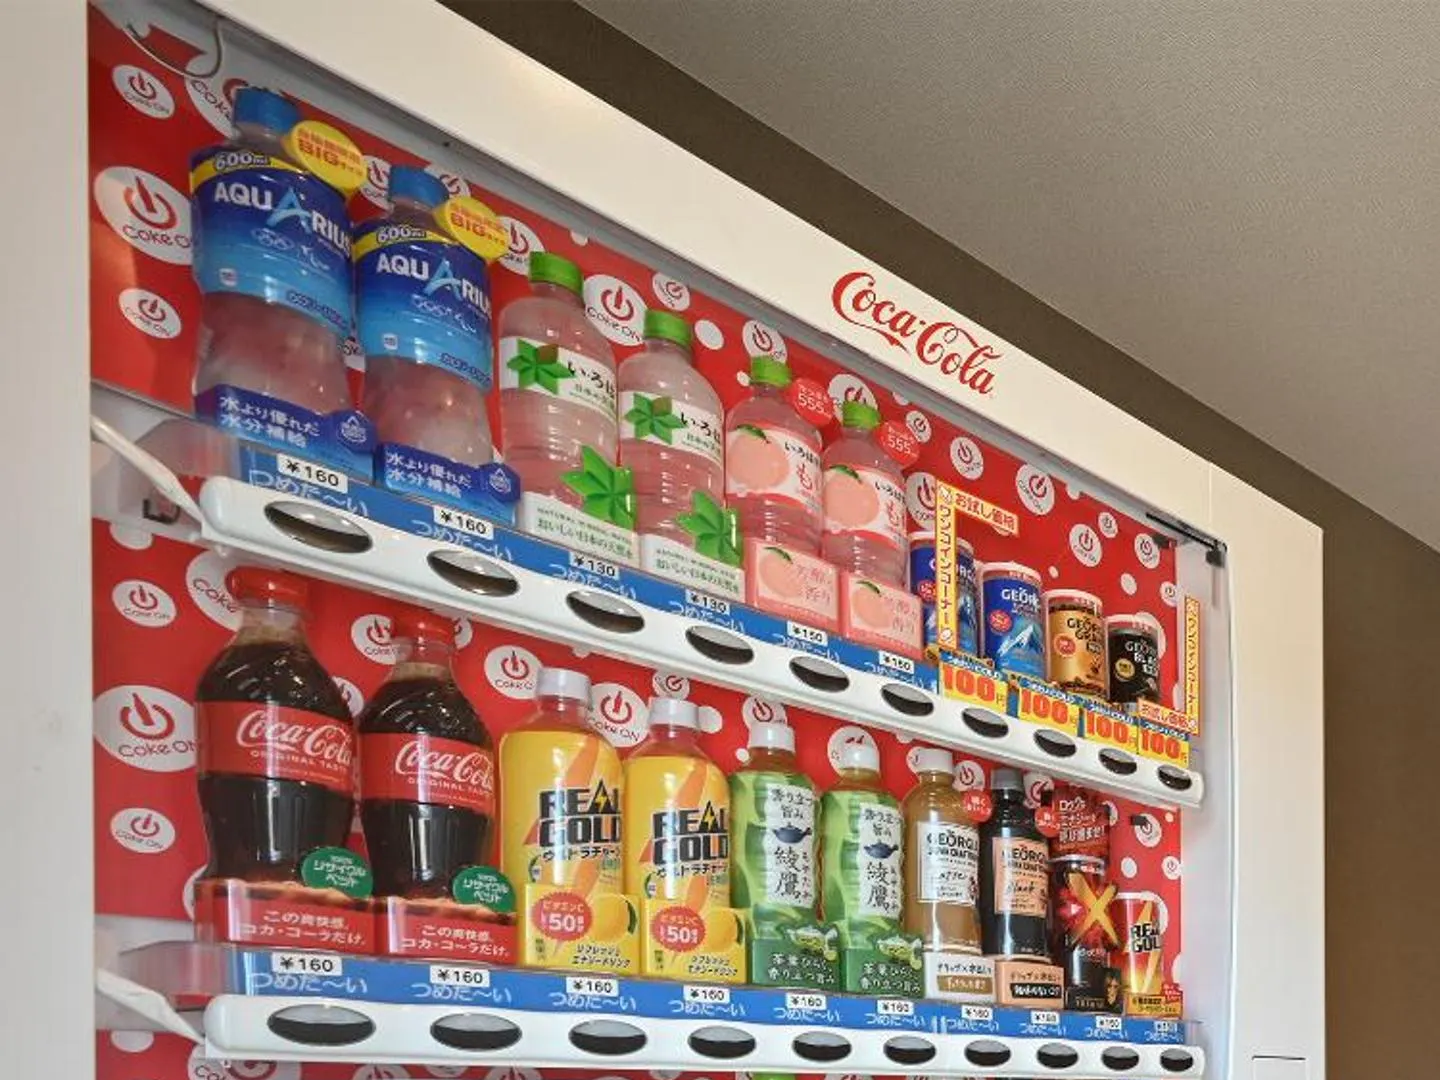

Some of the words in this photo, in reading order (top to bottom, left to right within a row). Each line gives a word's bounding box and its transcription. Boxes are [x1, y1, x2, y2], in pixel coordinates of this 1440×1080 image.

[214, 152, 270, 170] 600ml
[376, 226, 427, 243] 600ml
[375, 255, 492, 316] AQUARIU
[831, 271, 1003, 396] Coca-Cola
[220, 395, 320, 437] 水より優れた
[286, 461, 339, 486] ¥160
[440, 511, 486, 535] ¥160
[573, 555, 616, 577] ¥130
[690, 592, 728, 613] ¥130
[774, 846, 802, 900] 綾鷹
[280, 956, 334, 973] ¥160
[437, 968, 484, 985] ¥160
[572, 979, 614, 995] ¥160
